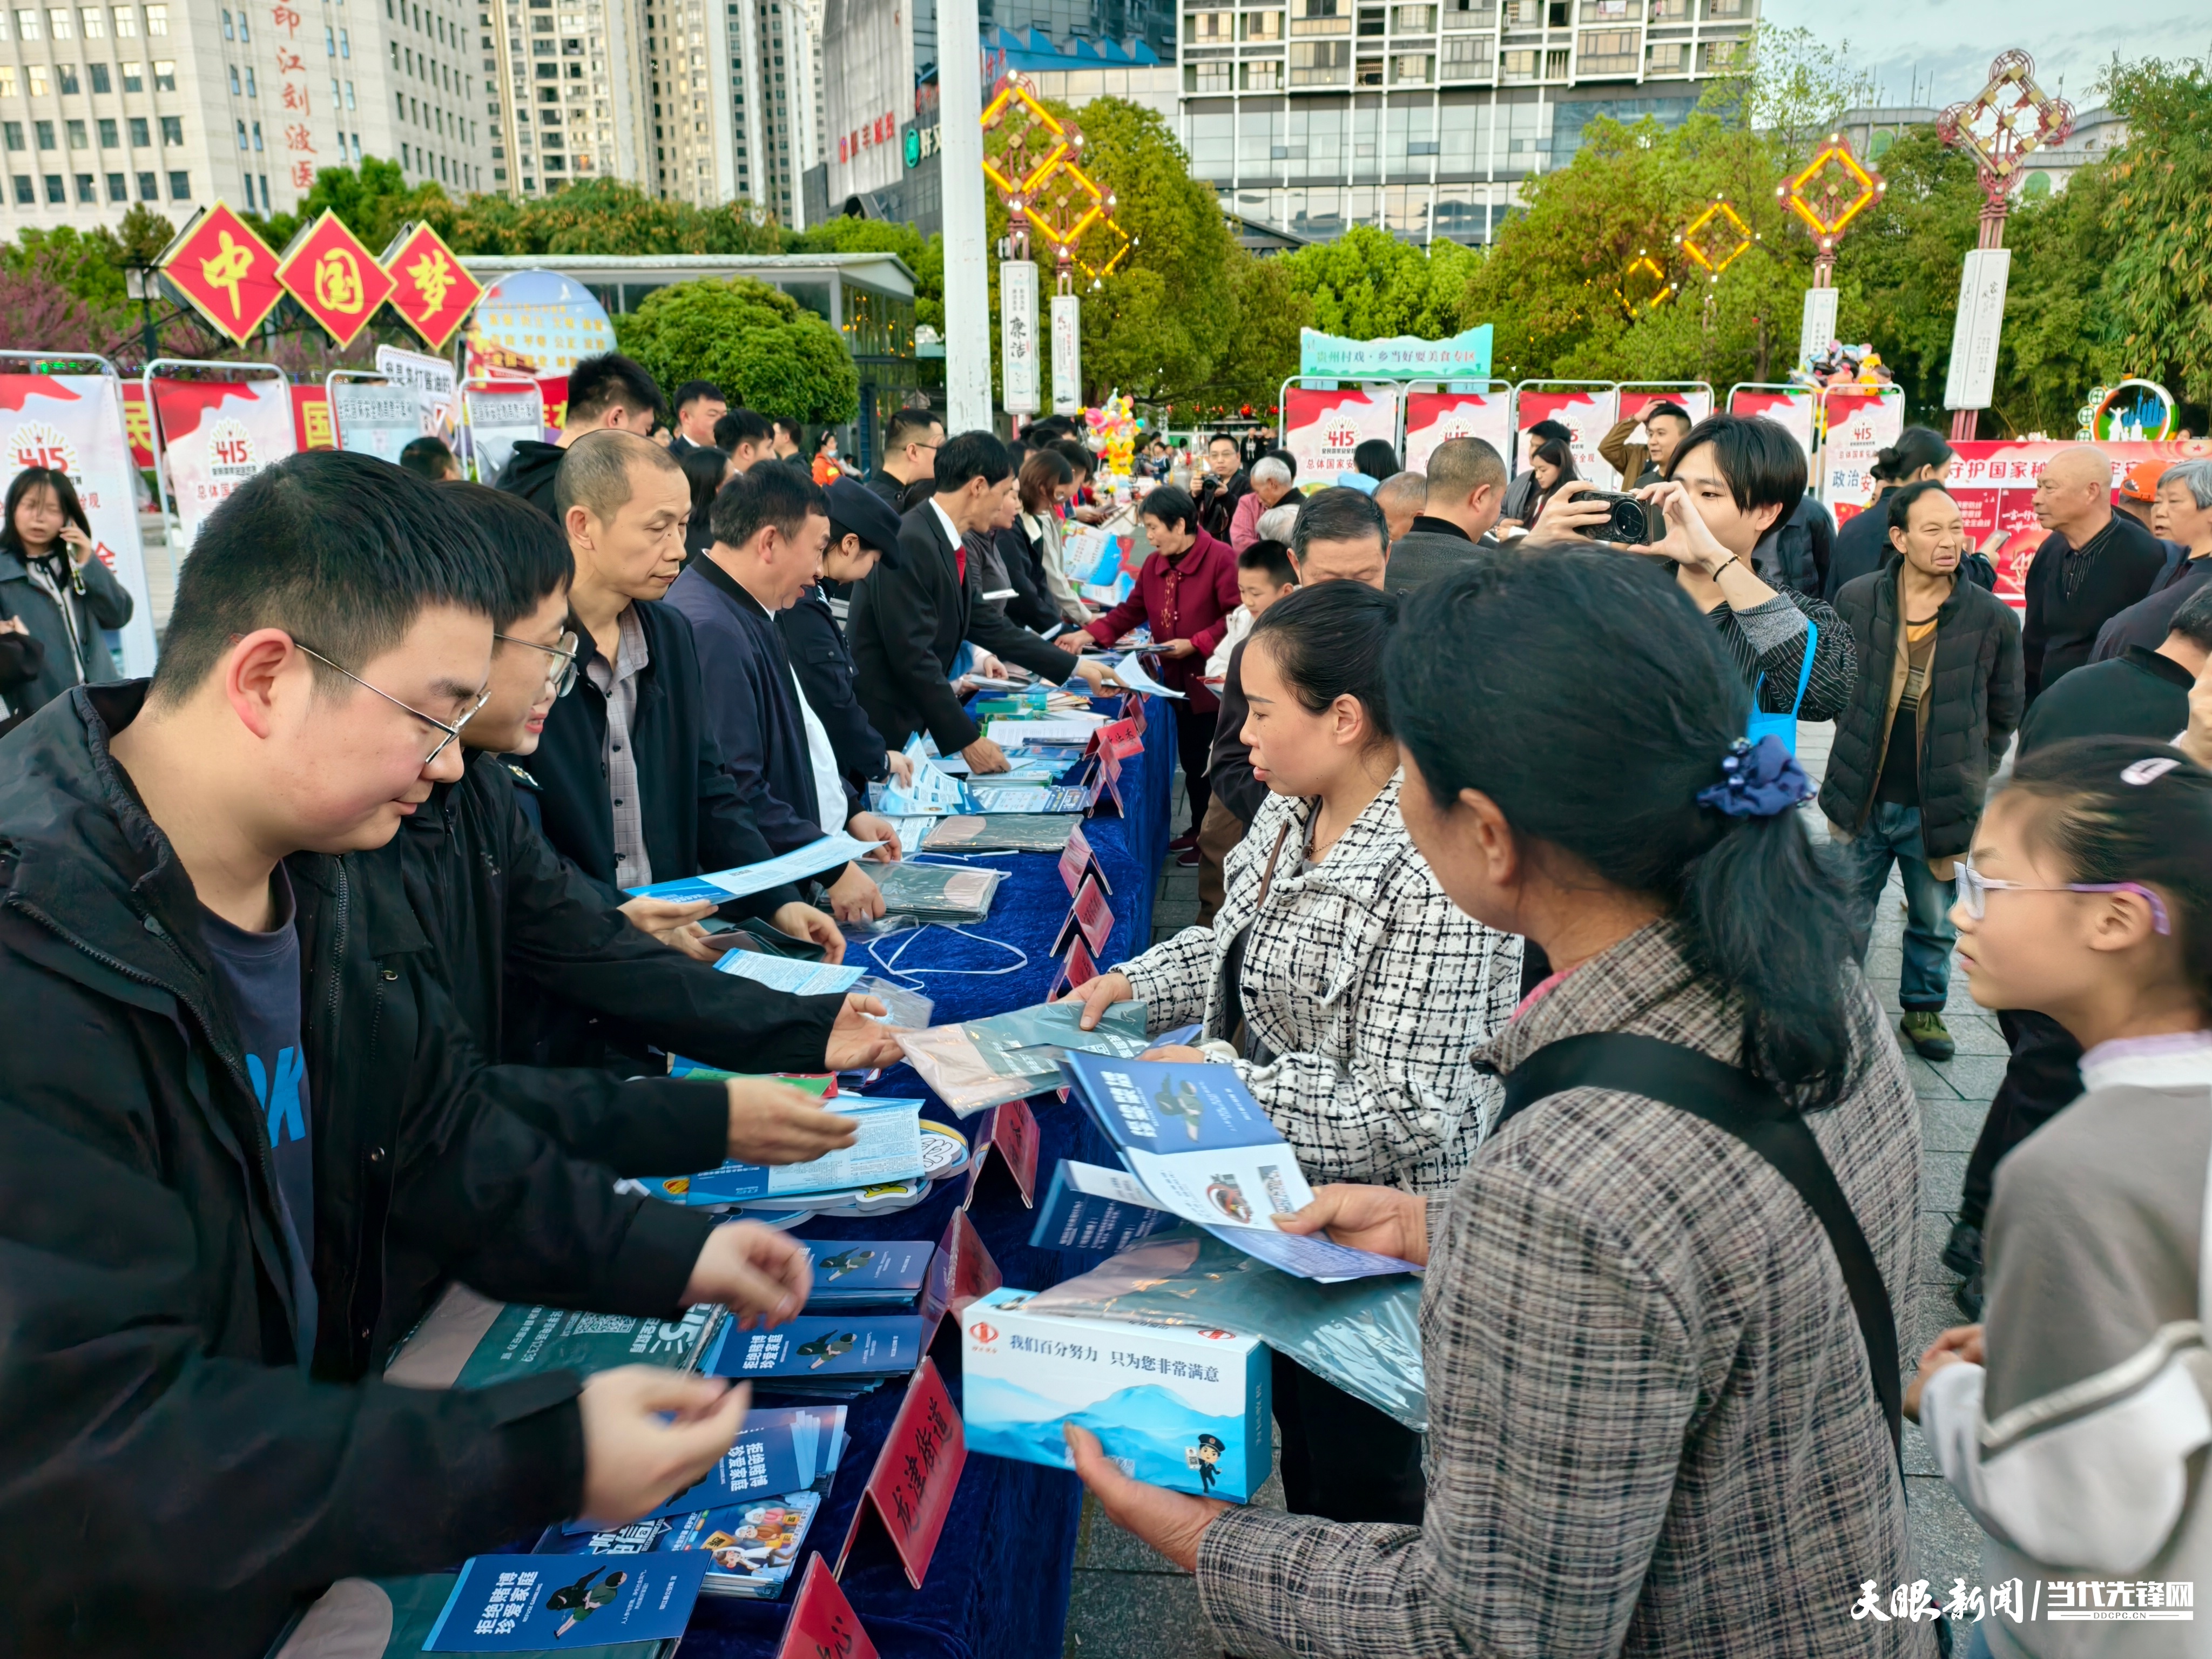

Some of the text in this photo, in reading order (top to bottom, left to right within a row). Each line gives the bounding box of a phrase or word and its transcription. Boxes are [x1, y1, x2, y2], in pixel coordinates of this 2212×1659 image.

[271, 0, 318, 188] 印江刘波医
[199, 231, 456, 322] 中国梦
[1328, 431, 1354, 447] 415
[1854, 428, 1872, 440] 415
[217, 441, 247, 464] 415
[198, 482, 239, 500] 总体国
[1832, 469, 1872, 493] 政治安
[743, 1334, 767, 1370] 拒绝赌博
[759, 1334, 784, 1369] 珍爱家庭
[1009, 1334, 1219, 1383] 我们百分努力 只为您非常满意
[727, 1445, 748, 1492] 珍爱家庭
[746, 1442, 768, 1487] 拒绝赌博
[474, 1572, 518, 1635] 拒绝赌博
[494, 1570, 539, 1634] 珍爱家庭
[522, 1604, 534, 1622] REFUSE
